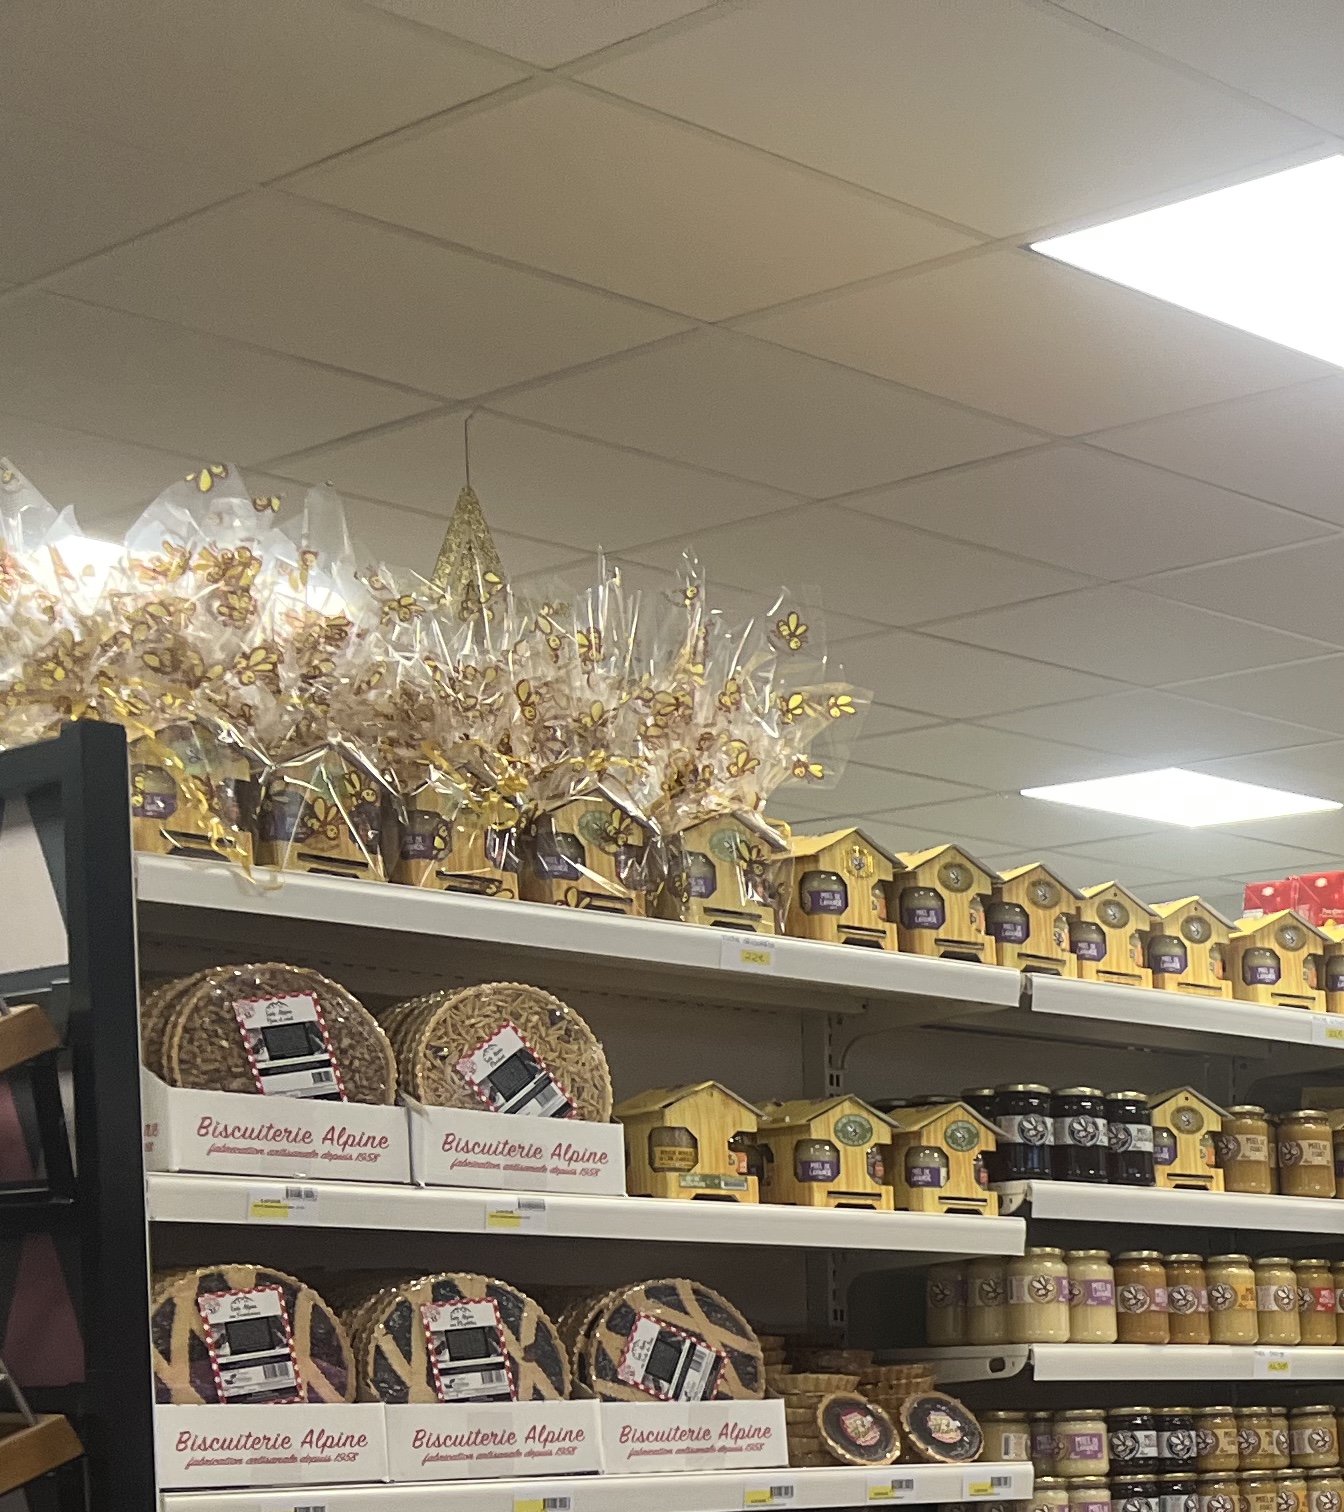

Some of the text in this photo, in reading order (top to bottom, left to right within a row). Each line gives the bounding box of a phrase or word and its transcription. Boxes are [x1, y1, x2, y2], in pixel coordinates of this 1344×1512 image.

[197, 1116, 389, 1151] Biscuiterie Alpine
[441, 1132, 608, 1167] Biscuiterie Alpine
[175, 1428, 368, 1453] Biscuiterie Alpine
[412, 1424, 585, 1449] Biscuiterie Alpine
[619, 1421, 772, 1444] Biscuiterie Alpine
